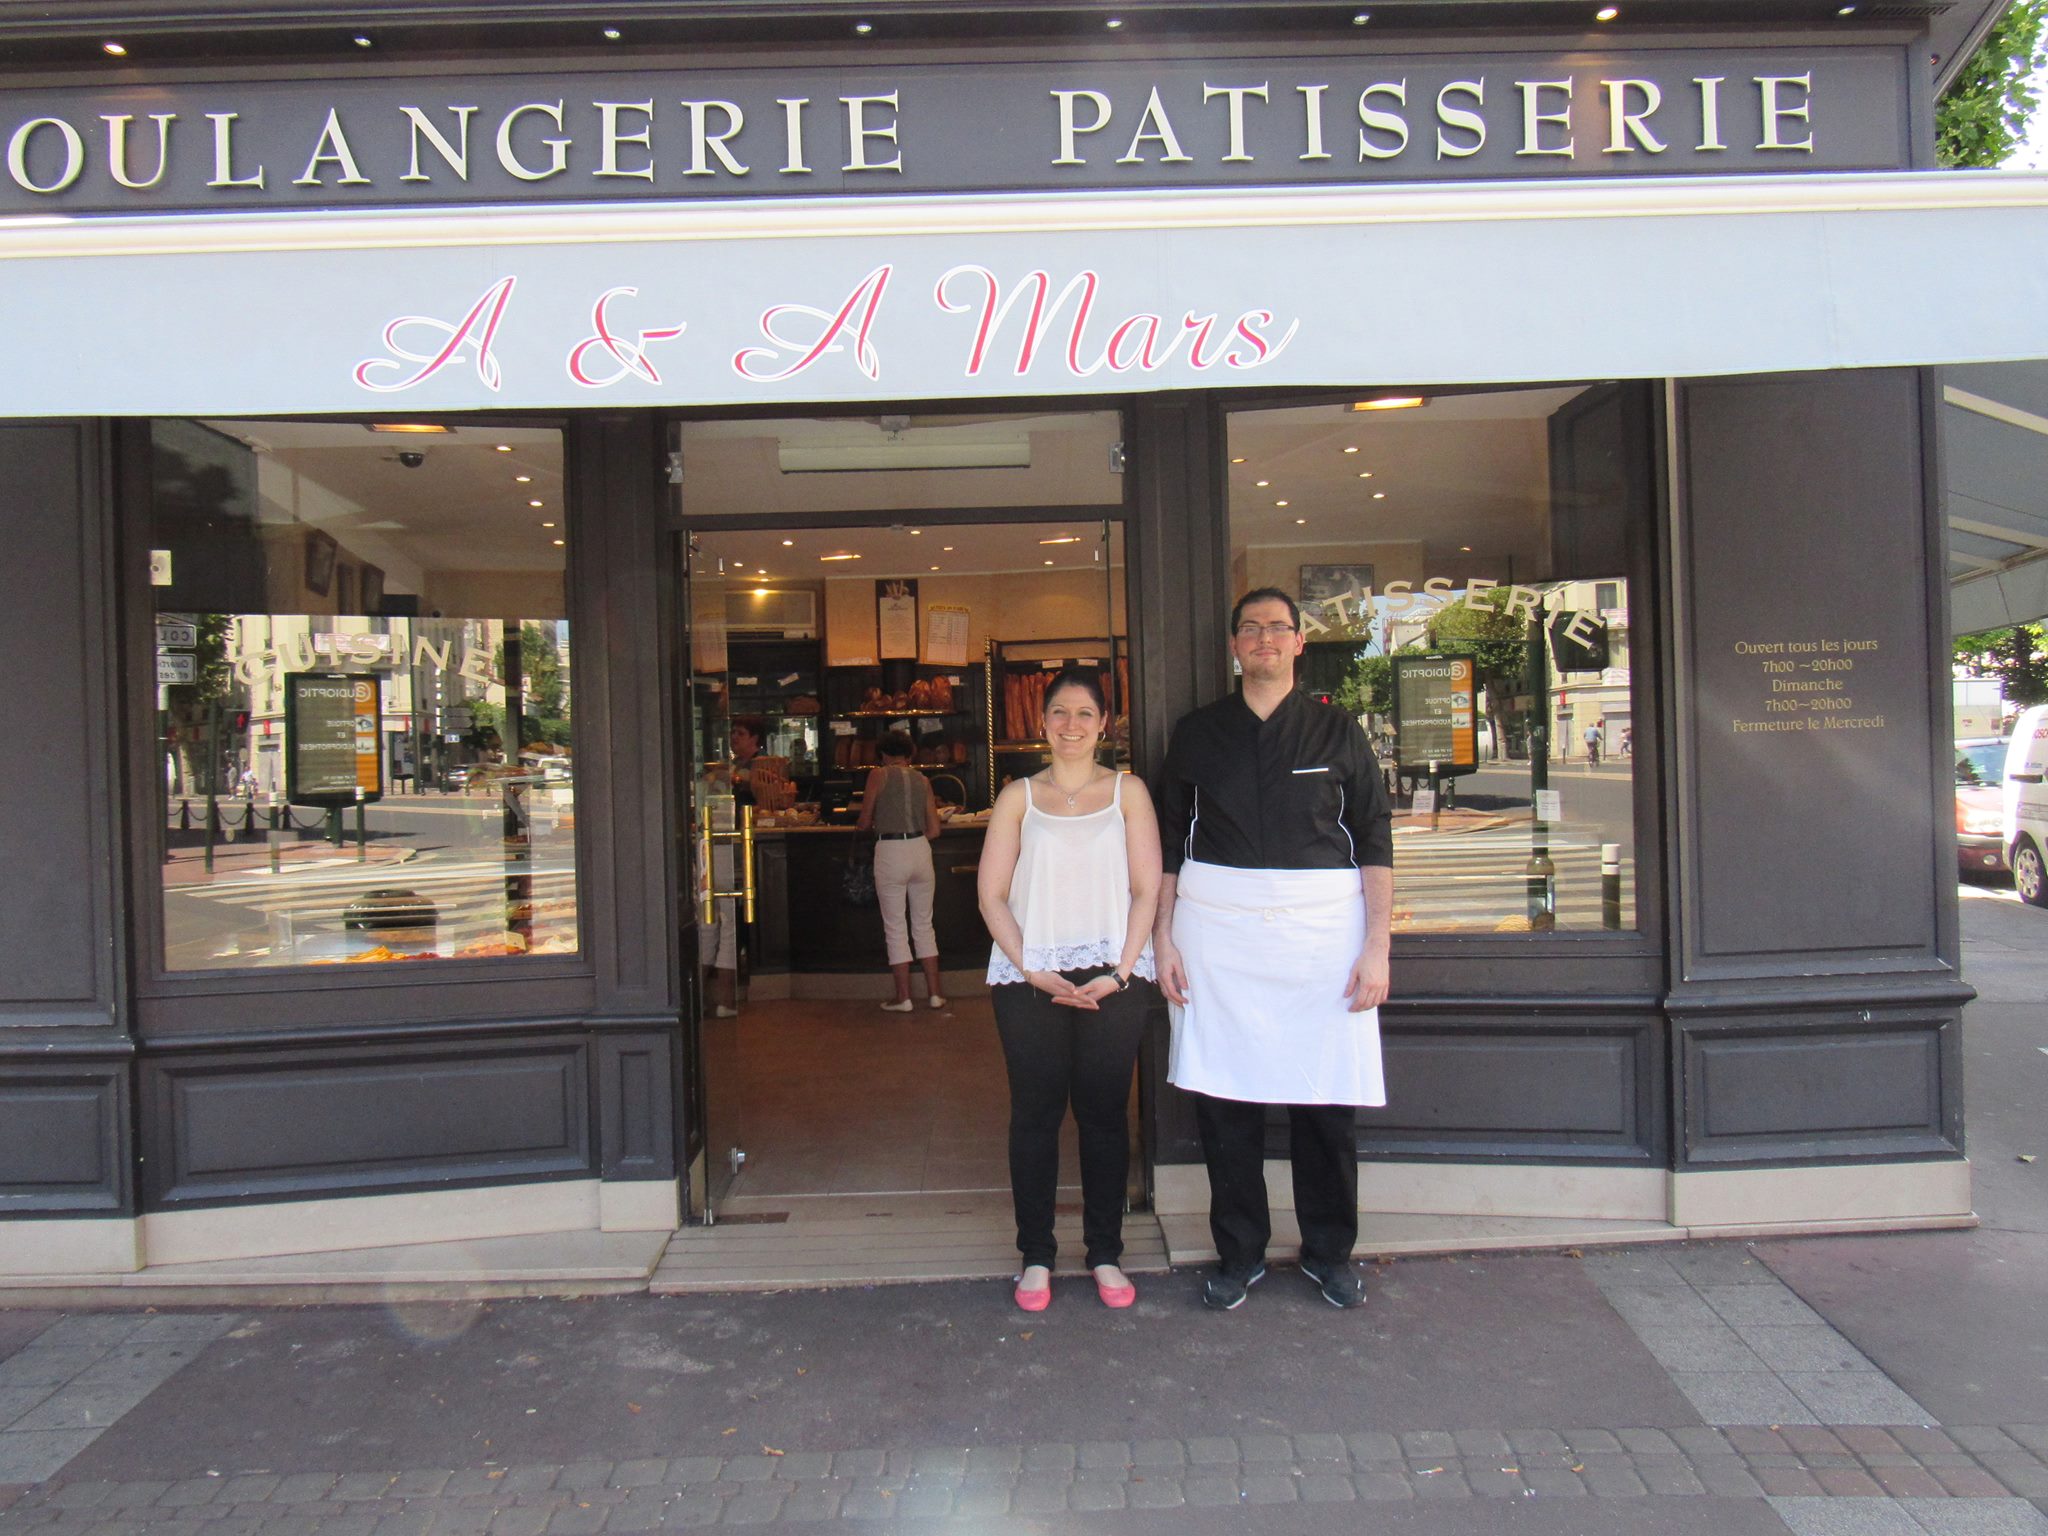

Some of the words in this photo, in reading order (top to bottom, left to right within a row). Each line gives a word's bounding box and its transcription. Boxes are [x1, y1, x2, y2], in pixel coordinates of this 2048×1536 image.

[6, 89, 903, 194] OULANGERIE
[1050, 70, 1816, 166] PATISSERIE
[353, 275, 517, 393] A
[566, 286, 687, 388] &
[731, 264, 893, 382] A
[934, 263, 1299, 379] Mars
[1735, 641, 1784, 654] Ouvert
[1788, 640, 1817, 653] tous
[1821, 639, 1839, 652] les
[1843, 639, 1878, 653] jours
[234, 632, 497, 686] CUISINE
[1762, 660, 1794, 673] 7h00
[1772, 678, 1843, 692] Dimanche
[1733, 718, 1804, 732] Fermeture
[1808, 717, 1820, 730] le
[1824, 715, 1885, 729] Mercredi
